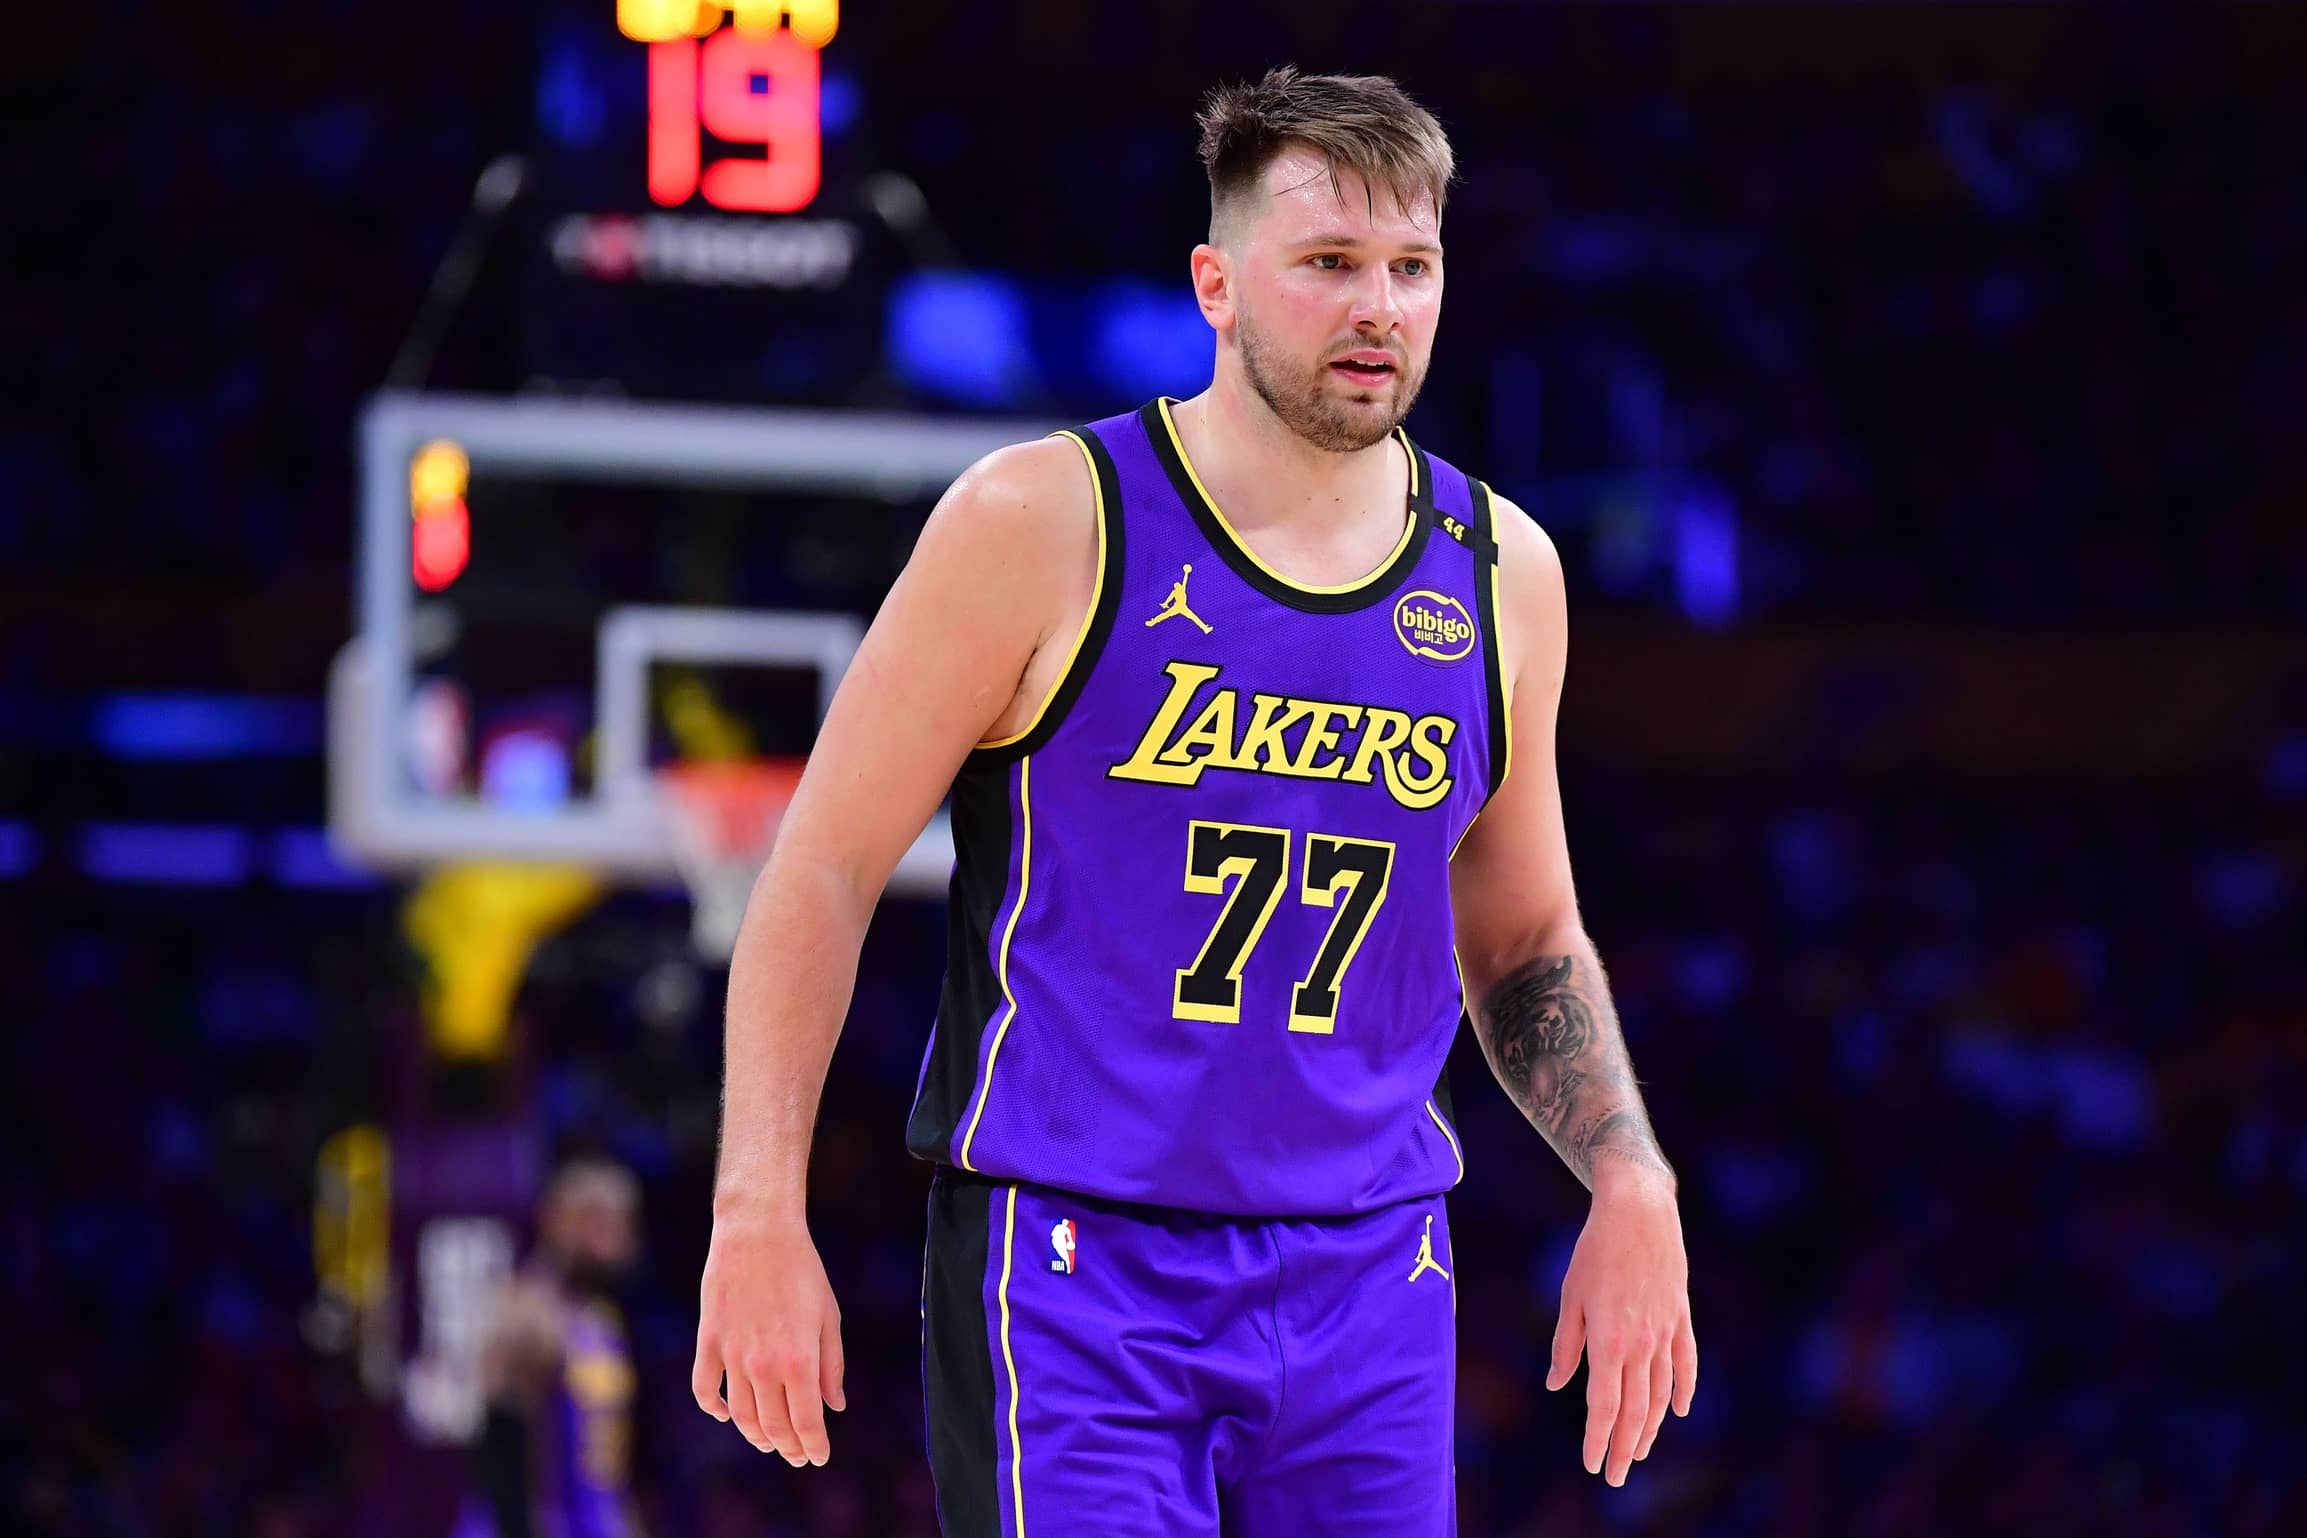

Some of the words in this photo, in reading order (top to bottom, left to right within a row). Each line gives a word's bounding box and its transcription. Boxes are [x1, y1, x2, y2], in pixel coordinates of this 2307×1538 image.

[648, 24, 822, 213] 19
[1443, 516, 1465, 541] 44
[1402, 605, 1470, 643] bibigo
[1414, 629, 1444, 645] 비비고
[1106, 660, 1457, 811] LAKERS
[1172, 819, 1396, 1035] 77
